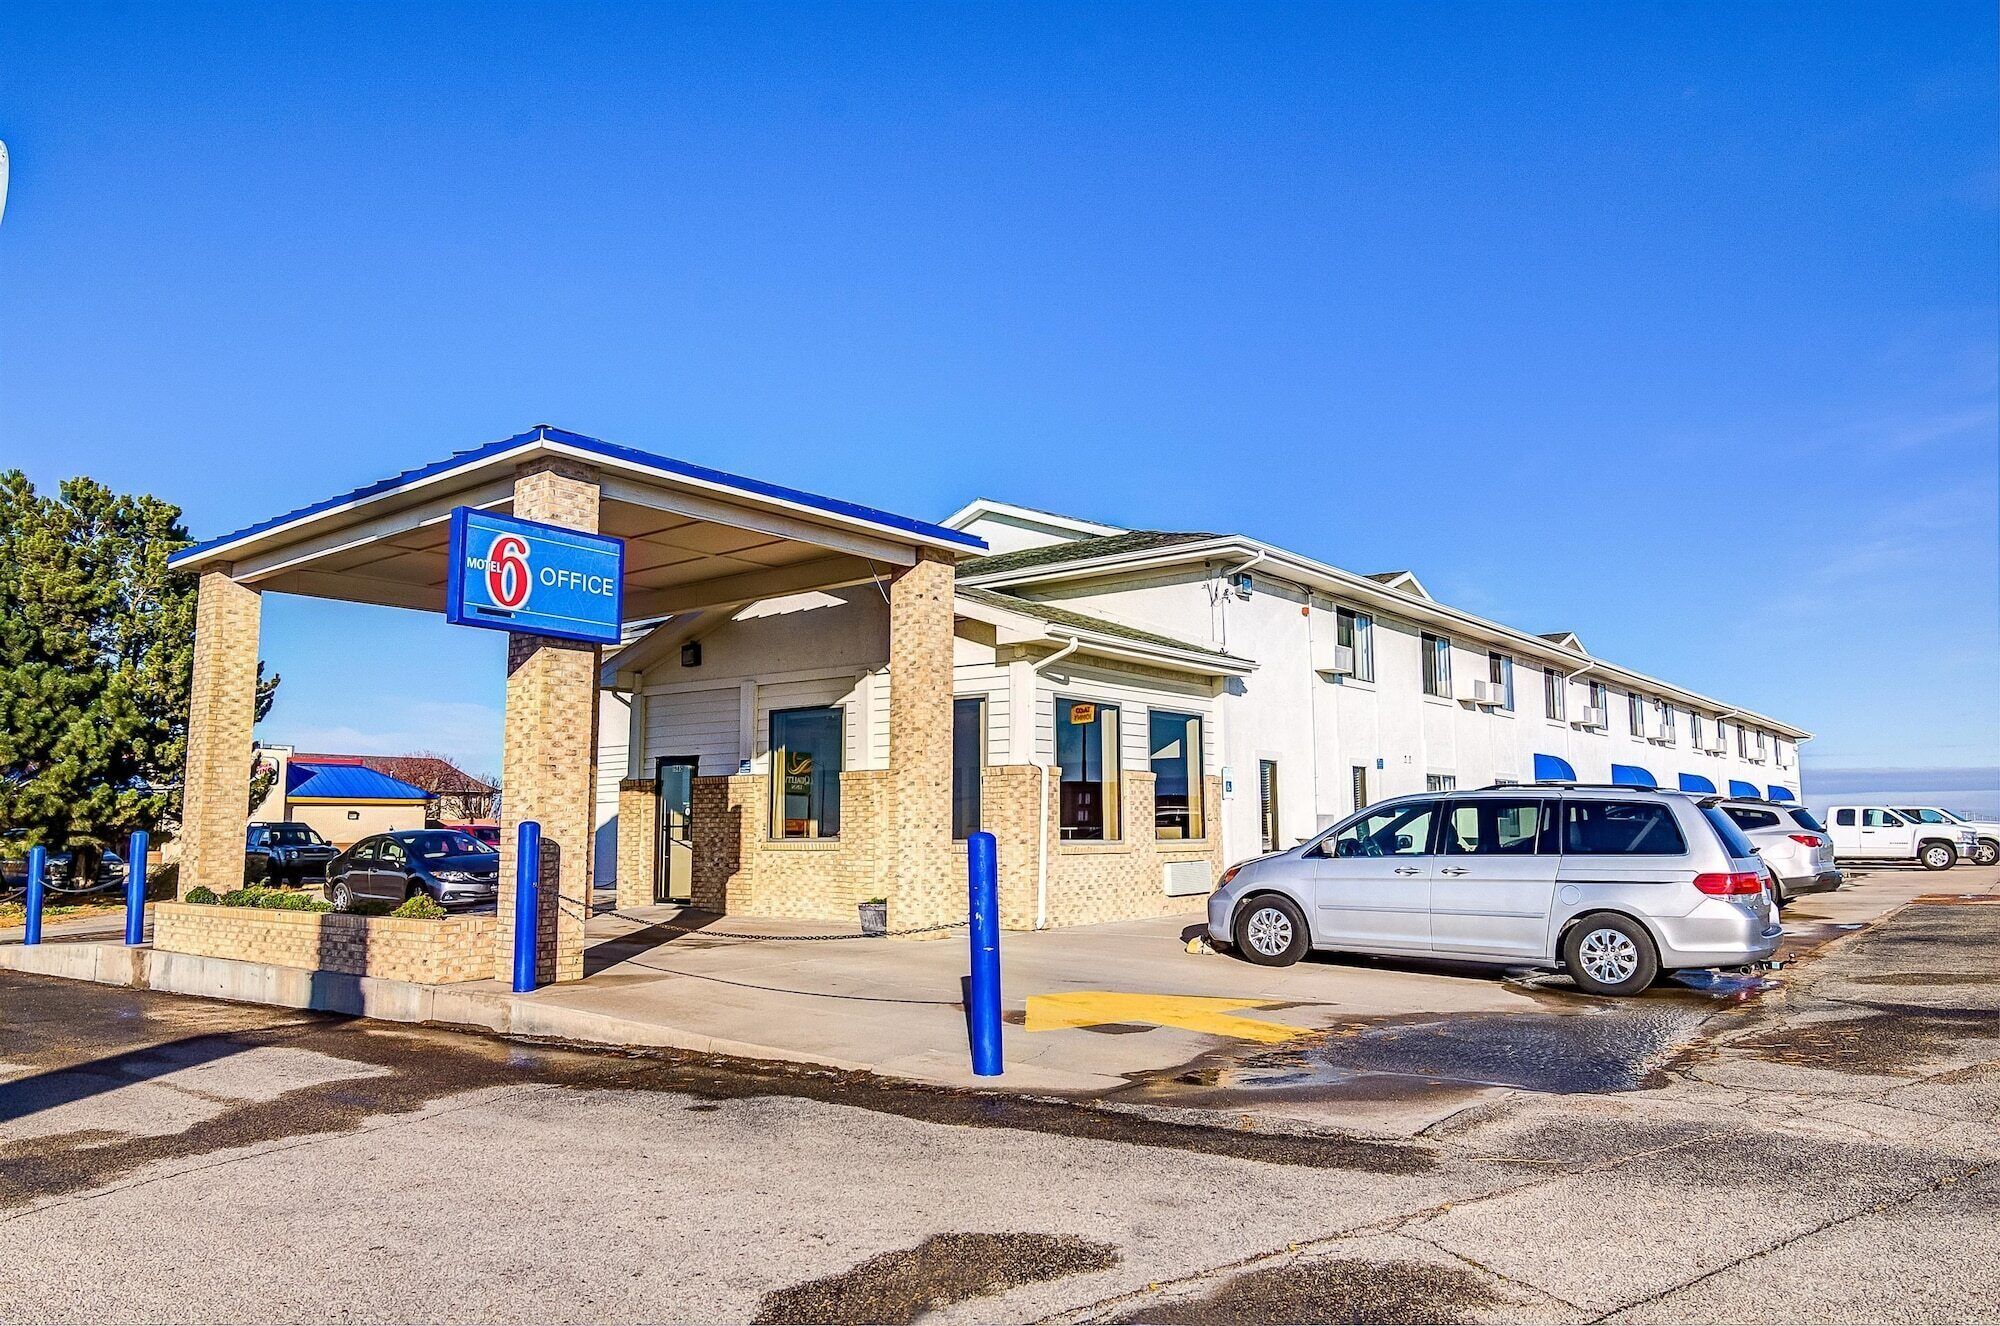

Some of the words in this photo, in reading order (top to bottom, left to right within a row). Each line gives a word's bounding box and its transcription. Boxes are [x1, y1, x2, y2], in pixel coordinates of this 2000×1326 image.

[466, 556, 503, 574] MOTEL
[487, 535, 530, 608] 6
[539, 566, 614, 597] OFFICE
